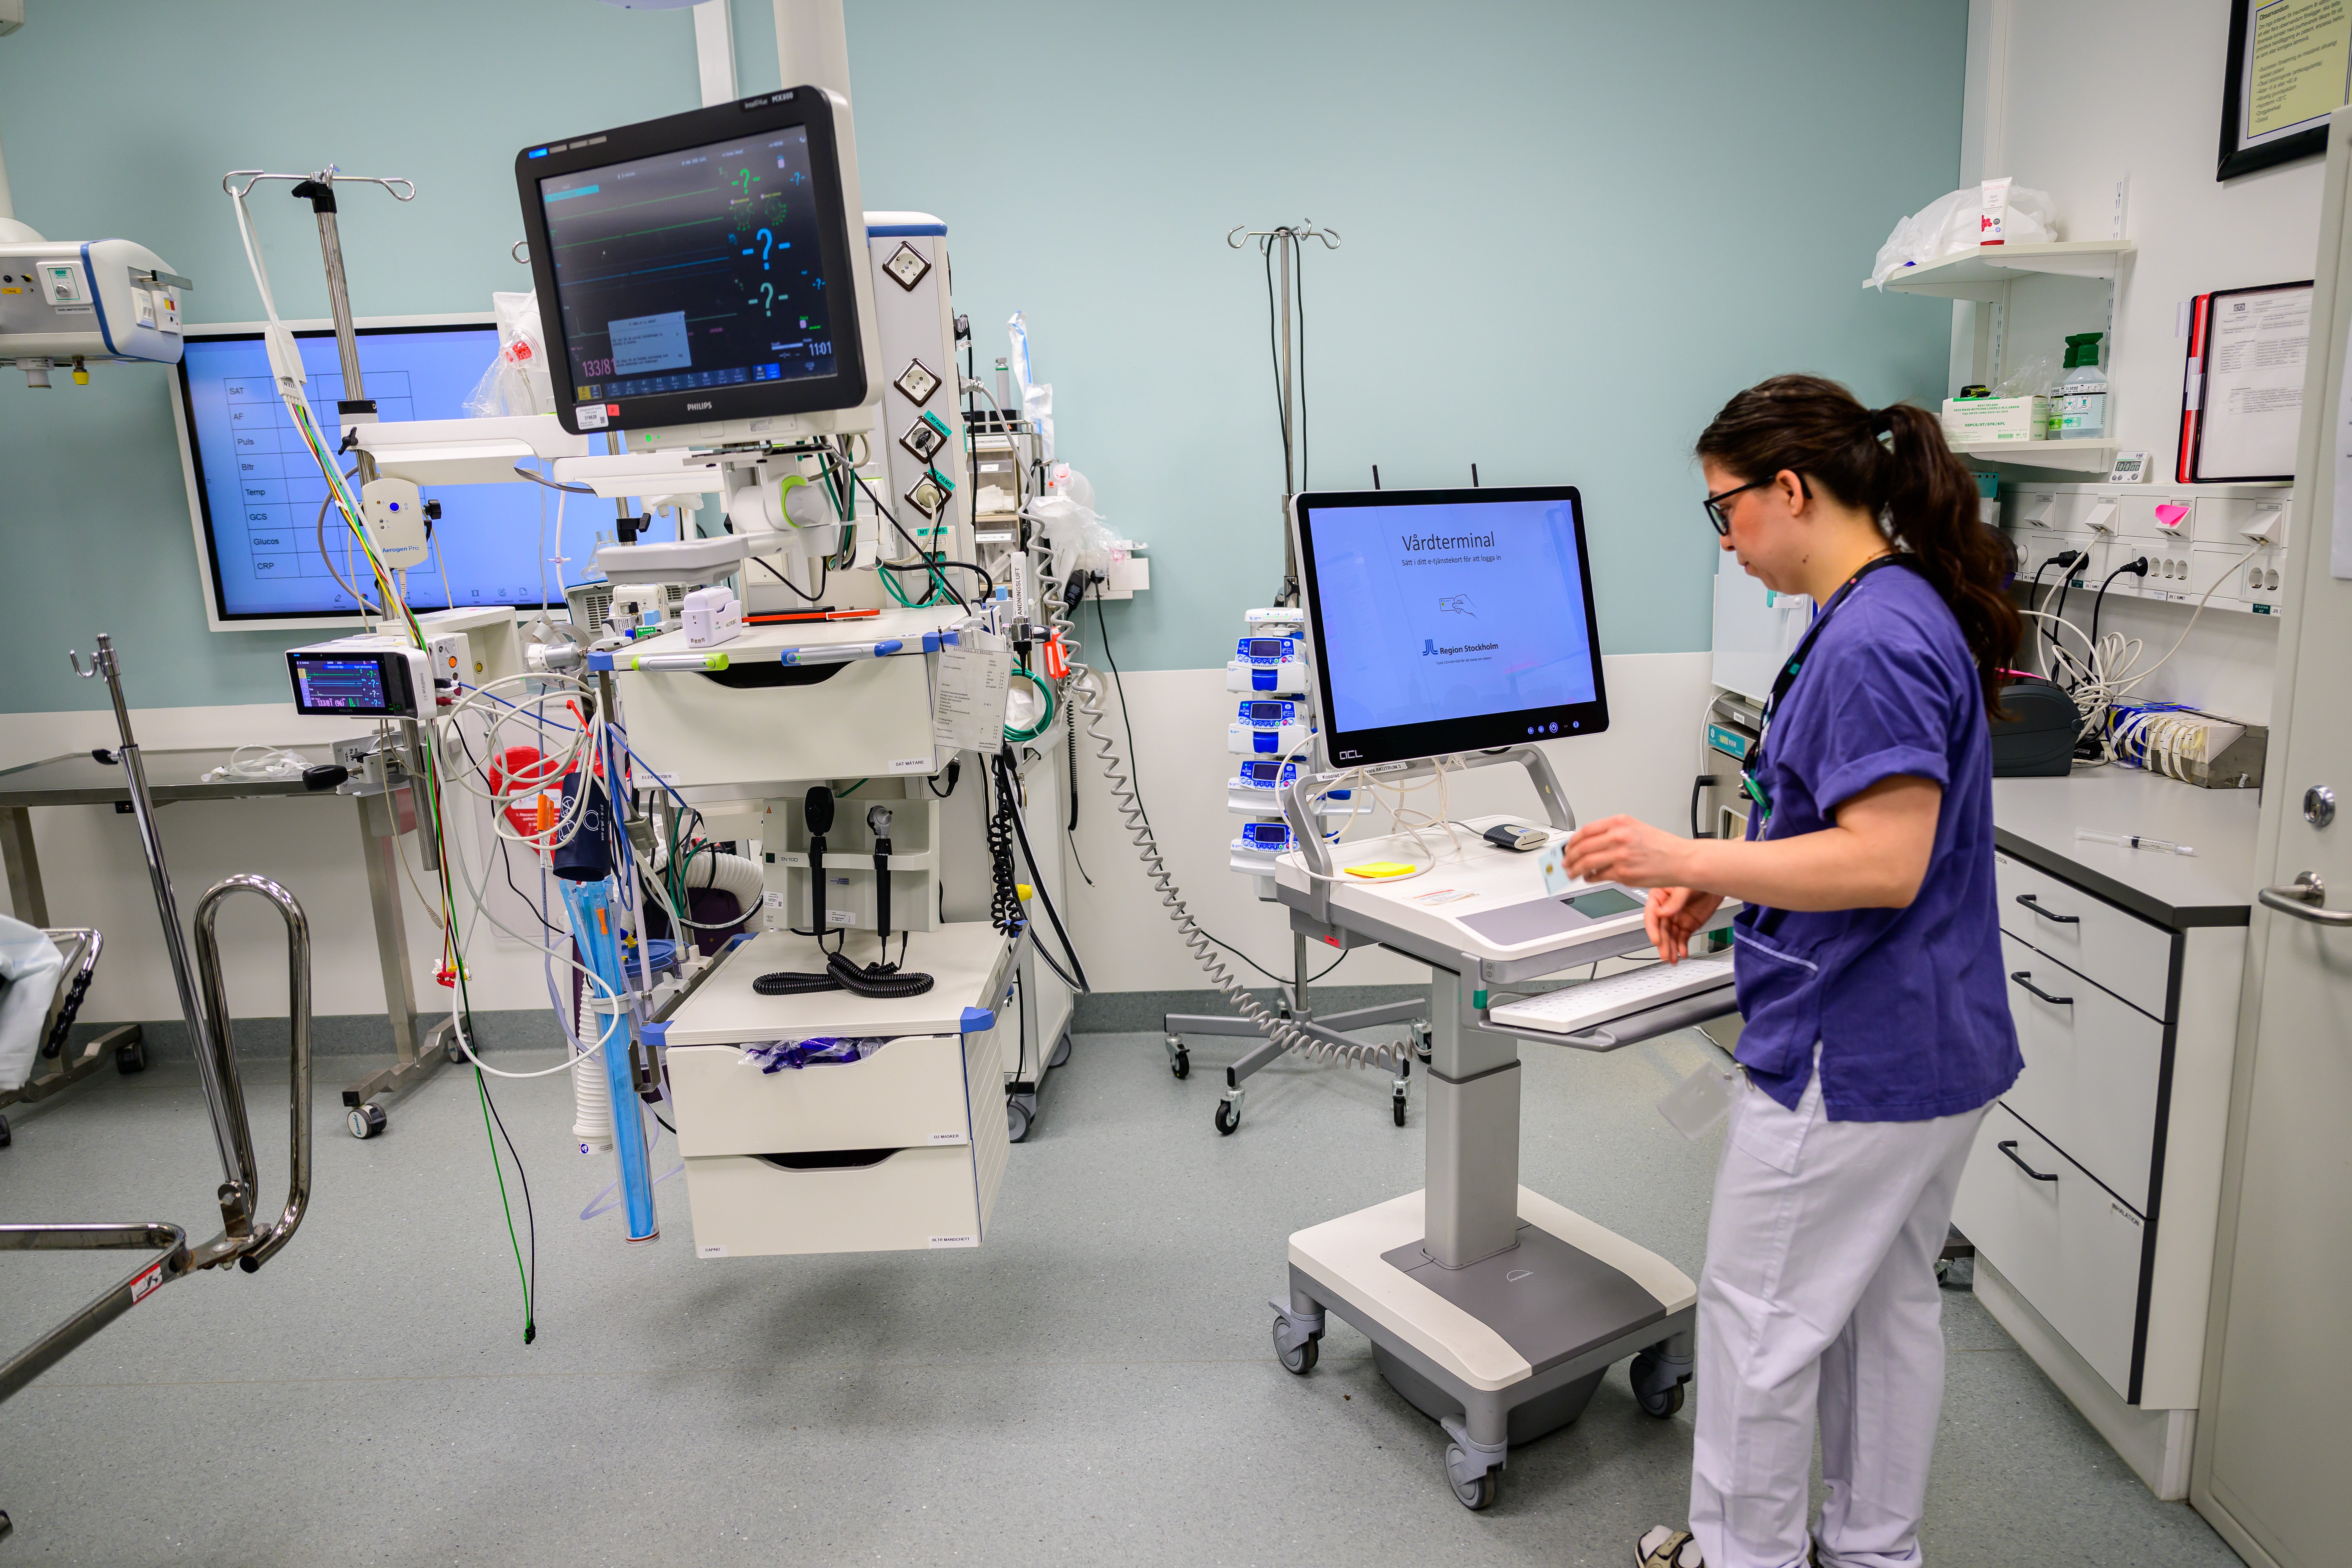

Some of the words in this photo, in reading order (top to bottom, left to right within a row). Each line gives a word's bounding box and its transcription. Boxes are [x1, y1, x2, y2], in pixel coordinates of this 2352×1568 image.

[2259, 5, 2289, 20] Observandum
[2293, 4, 2313, 16] traumalarm
[2279, 16, 2303, 29] observandum
[2257, 36, 2273, 45] föranleda
[2274, 29, 2286, 38] kontakt
[2295, 18, 2318, 31] jourhavande
[2272, 33, 2295, 46] handläggning
[2316, 20, 2332, 29] anpassa
[2332, 14, 2345, 23] behov
[2259, 71, 2272, 80] skadad
[2272, 67, 2284, 75] patient
[809, 341, 832, 356] 11:01
[687, 401, 712, 411] PHILIPS
[936, 422, 946, 431] PAMS
[938, 475, 953, 488] PAMS
[1402, 531, 1495, 551] Vårdterminal
[1428, 557, 1463, 565] e-tjänstekort
[726, 619, 735, 628] AKUTRUM
[1440, 646, 1463, 655] Region
[1464, 642, 1499, 652] Stockholm
[601, 833, 604, 841] cm
[2112, 1202, 2139, 1226] INHALATION
